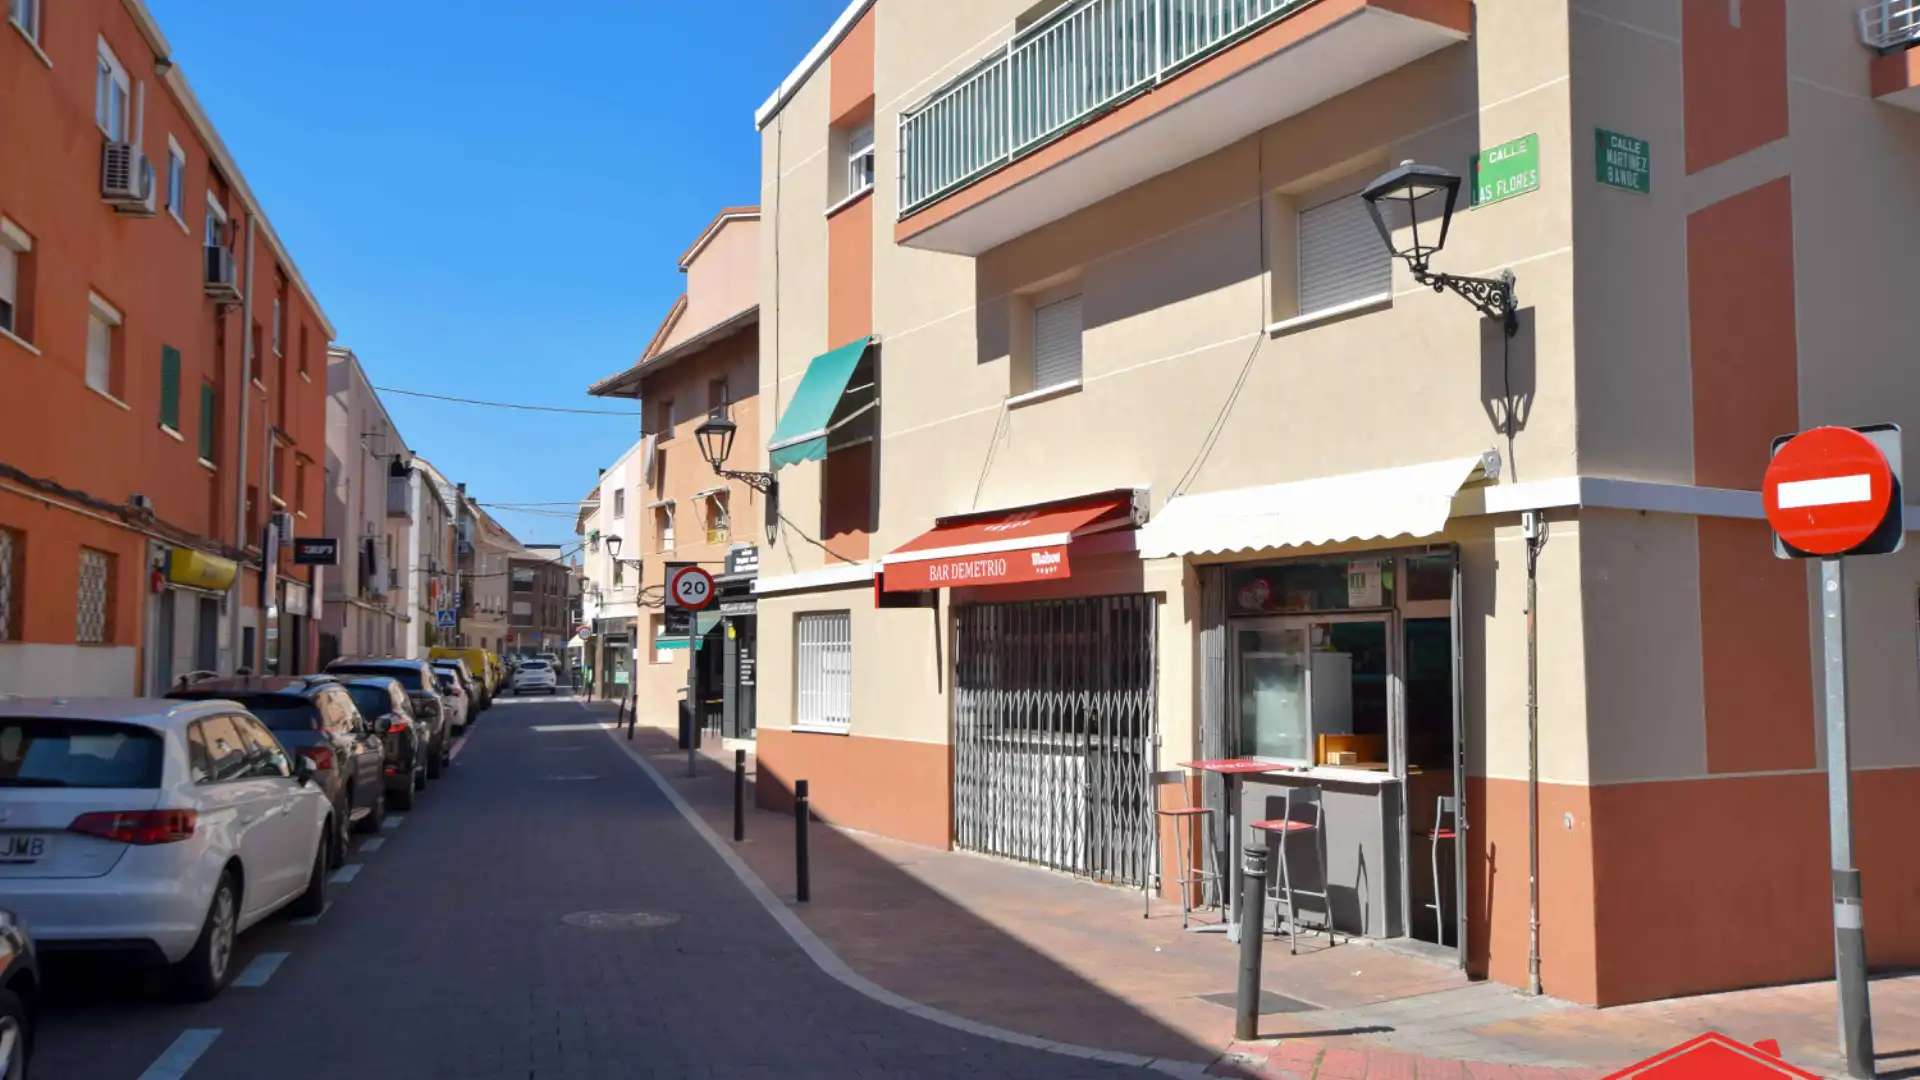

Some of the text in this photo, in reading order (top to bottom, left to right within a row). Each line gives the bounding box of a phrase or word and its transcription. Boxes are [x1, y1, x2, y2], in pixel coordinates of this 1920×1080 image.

[1489, 140, 1527, 164] CALLE
[1611, 136, 1641, 154] CALLE
[1607, 148, 1647, 172] MARTINEZ
[1473, 170, 1537, 203] LAS FLORES
[929, 559, 1007, 581] BAR DEMETRIO
[682, 581, 706, 595] 20
[0, 836, 45, 856] JMB
